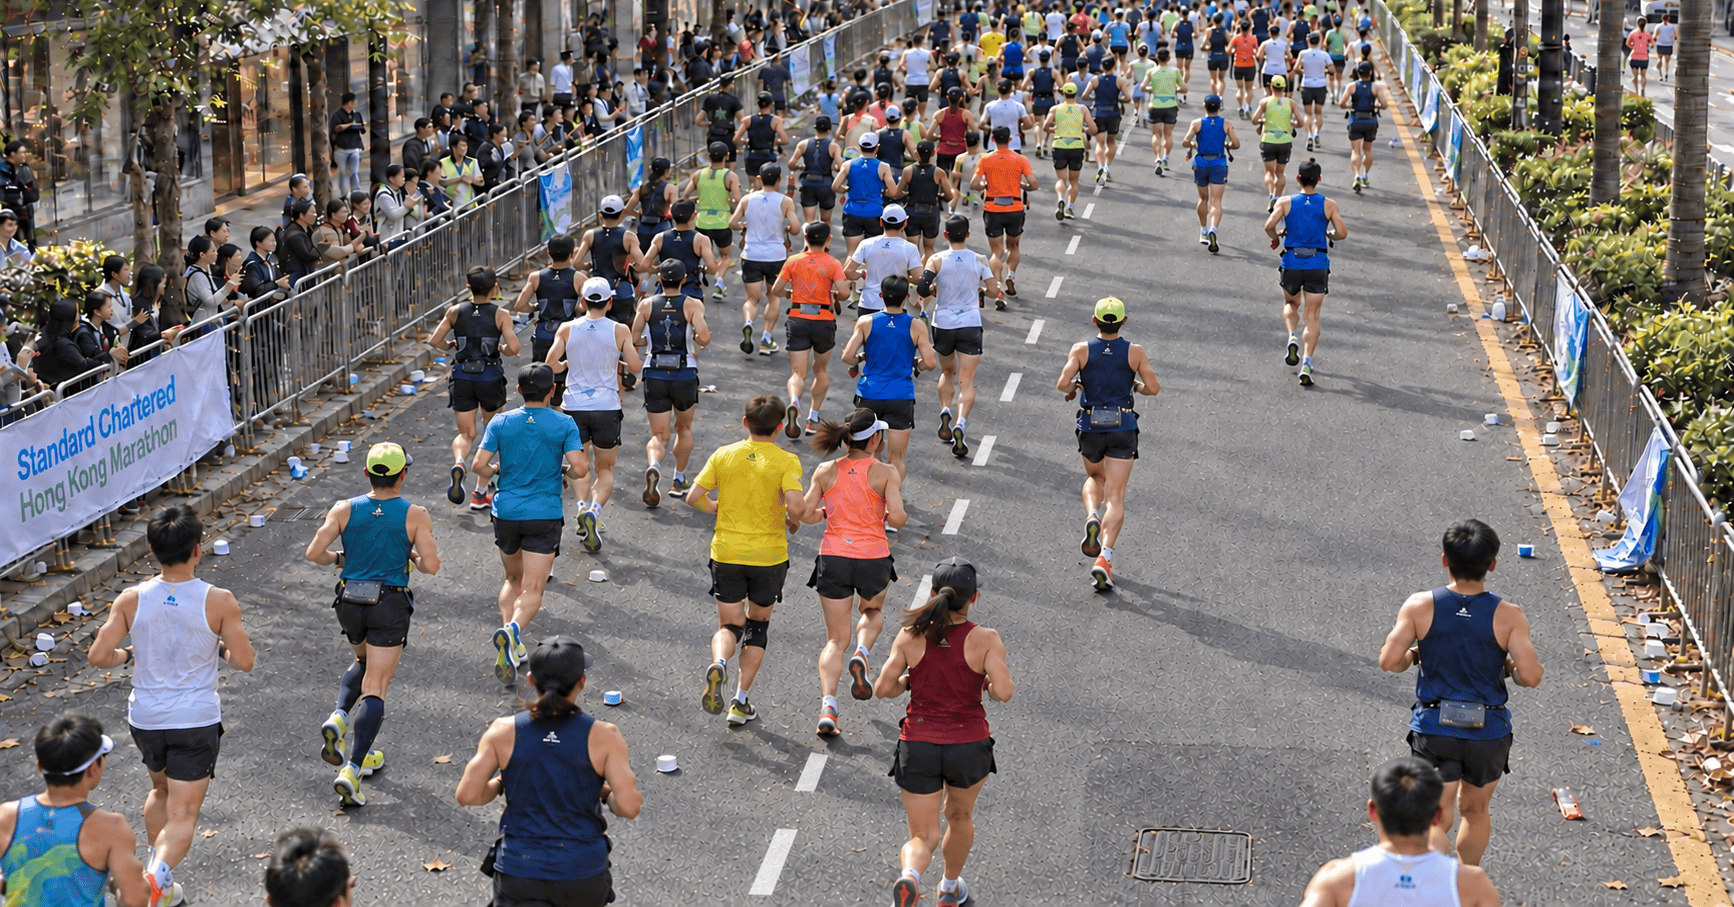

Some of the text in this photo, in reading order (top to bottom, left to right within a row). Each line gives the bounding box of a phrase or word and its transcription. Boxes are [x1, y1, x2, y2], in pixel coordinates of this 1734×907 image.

[18, 374, 176, 480] Standard Chartered
[20, 419, 177, 522] Hong Kong Marathon
